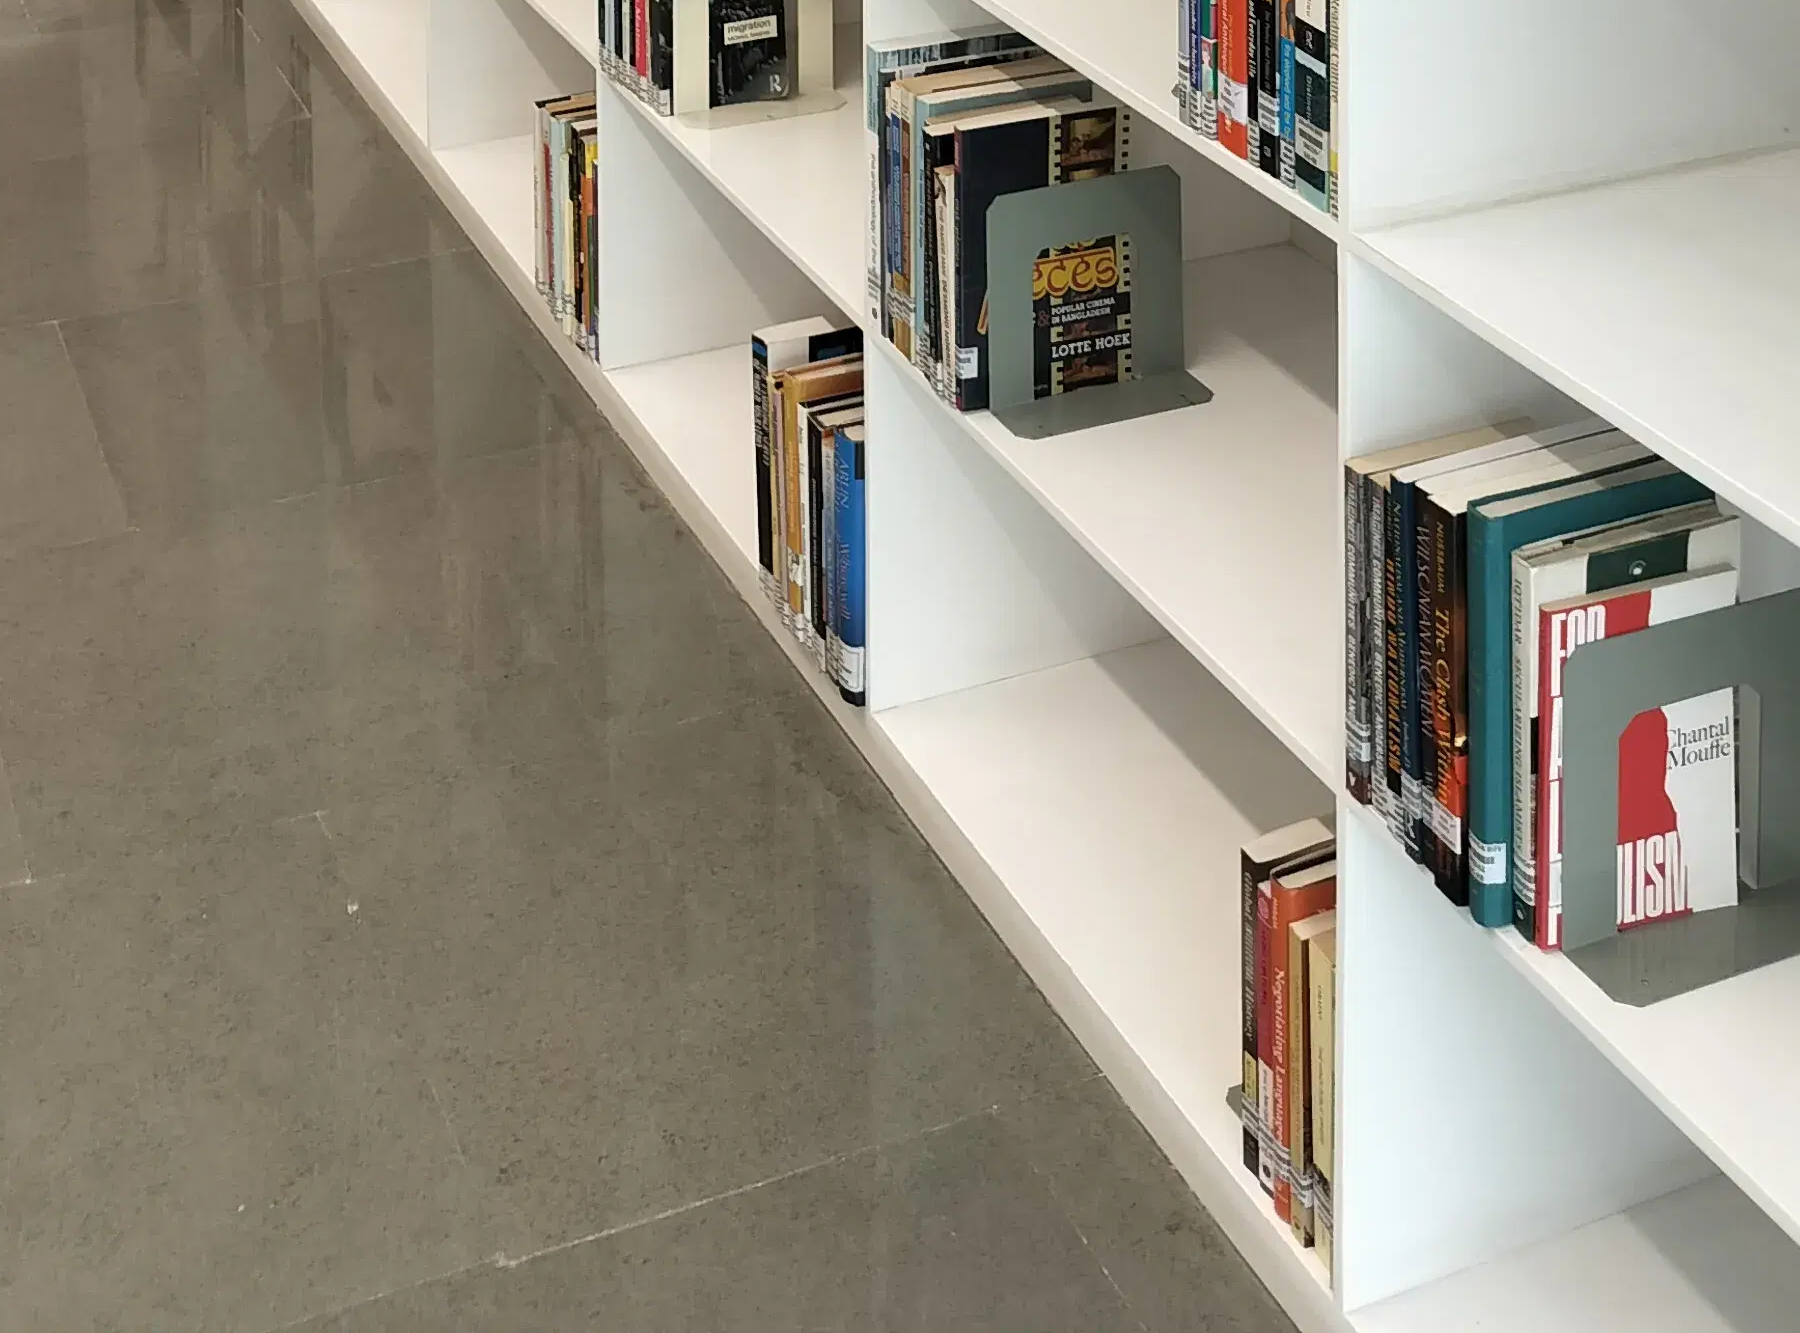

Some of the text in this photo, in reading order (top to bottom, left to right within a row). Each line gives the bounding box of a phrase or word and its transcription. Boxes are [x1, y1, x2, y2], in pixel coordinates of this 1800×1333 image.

[726, 17, 771, 35] migration
[1247, 17, 1257, 58] Everyday
[1051, 296, 1116, 316] POPULAR CINEMA
[1051, 332, 1131, 359] LOTTE HOEK
[1347, 481, 1357, 692] IMAGINED COMMUNITIES BENEDICT
[1435, 521, 1445, 594] NUSSBAUM
[1373, 496, 1384, 713] IMAGINED COMMUNITIES BENEDICT
[1416, 525, 1437, 738] WILSONIAN MOMENT
[1514, 577, 1524, 645] IQTIDAR
[1386, 558, 1401, 773] HINDU NATIONALISM
[1435, 608, 1453, 806] The Clash Within
[1514, 658, 1524, 768] SECULARIZING
[1666, 715, 1730, 750] Chantal
[1667, 738, 1732, 771] Mouffe
[1244, 996, 1256, 1052] History
[1271, 967, 1286, 1063] Negotiating
